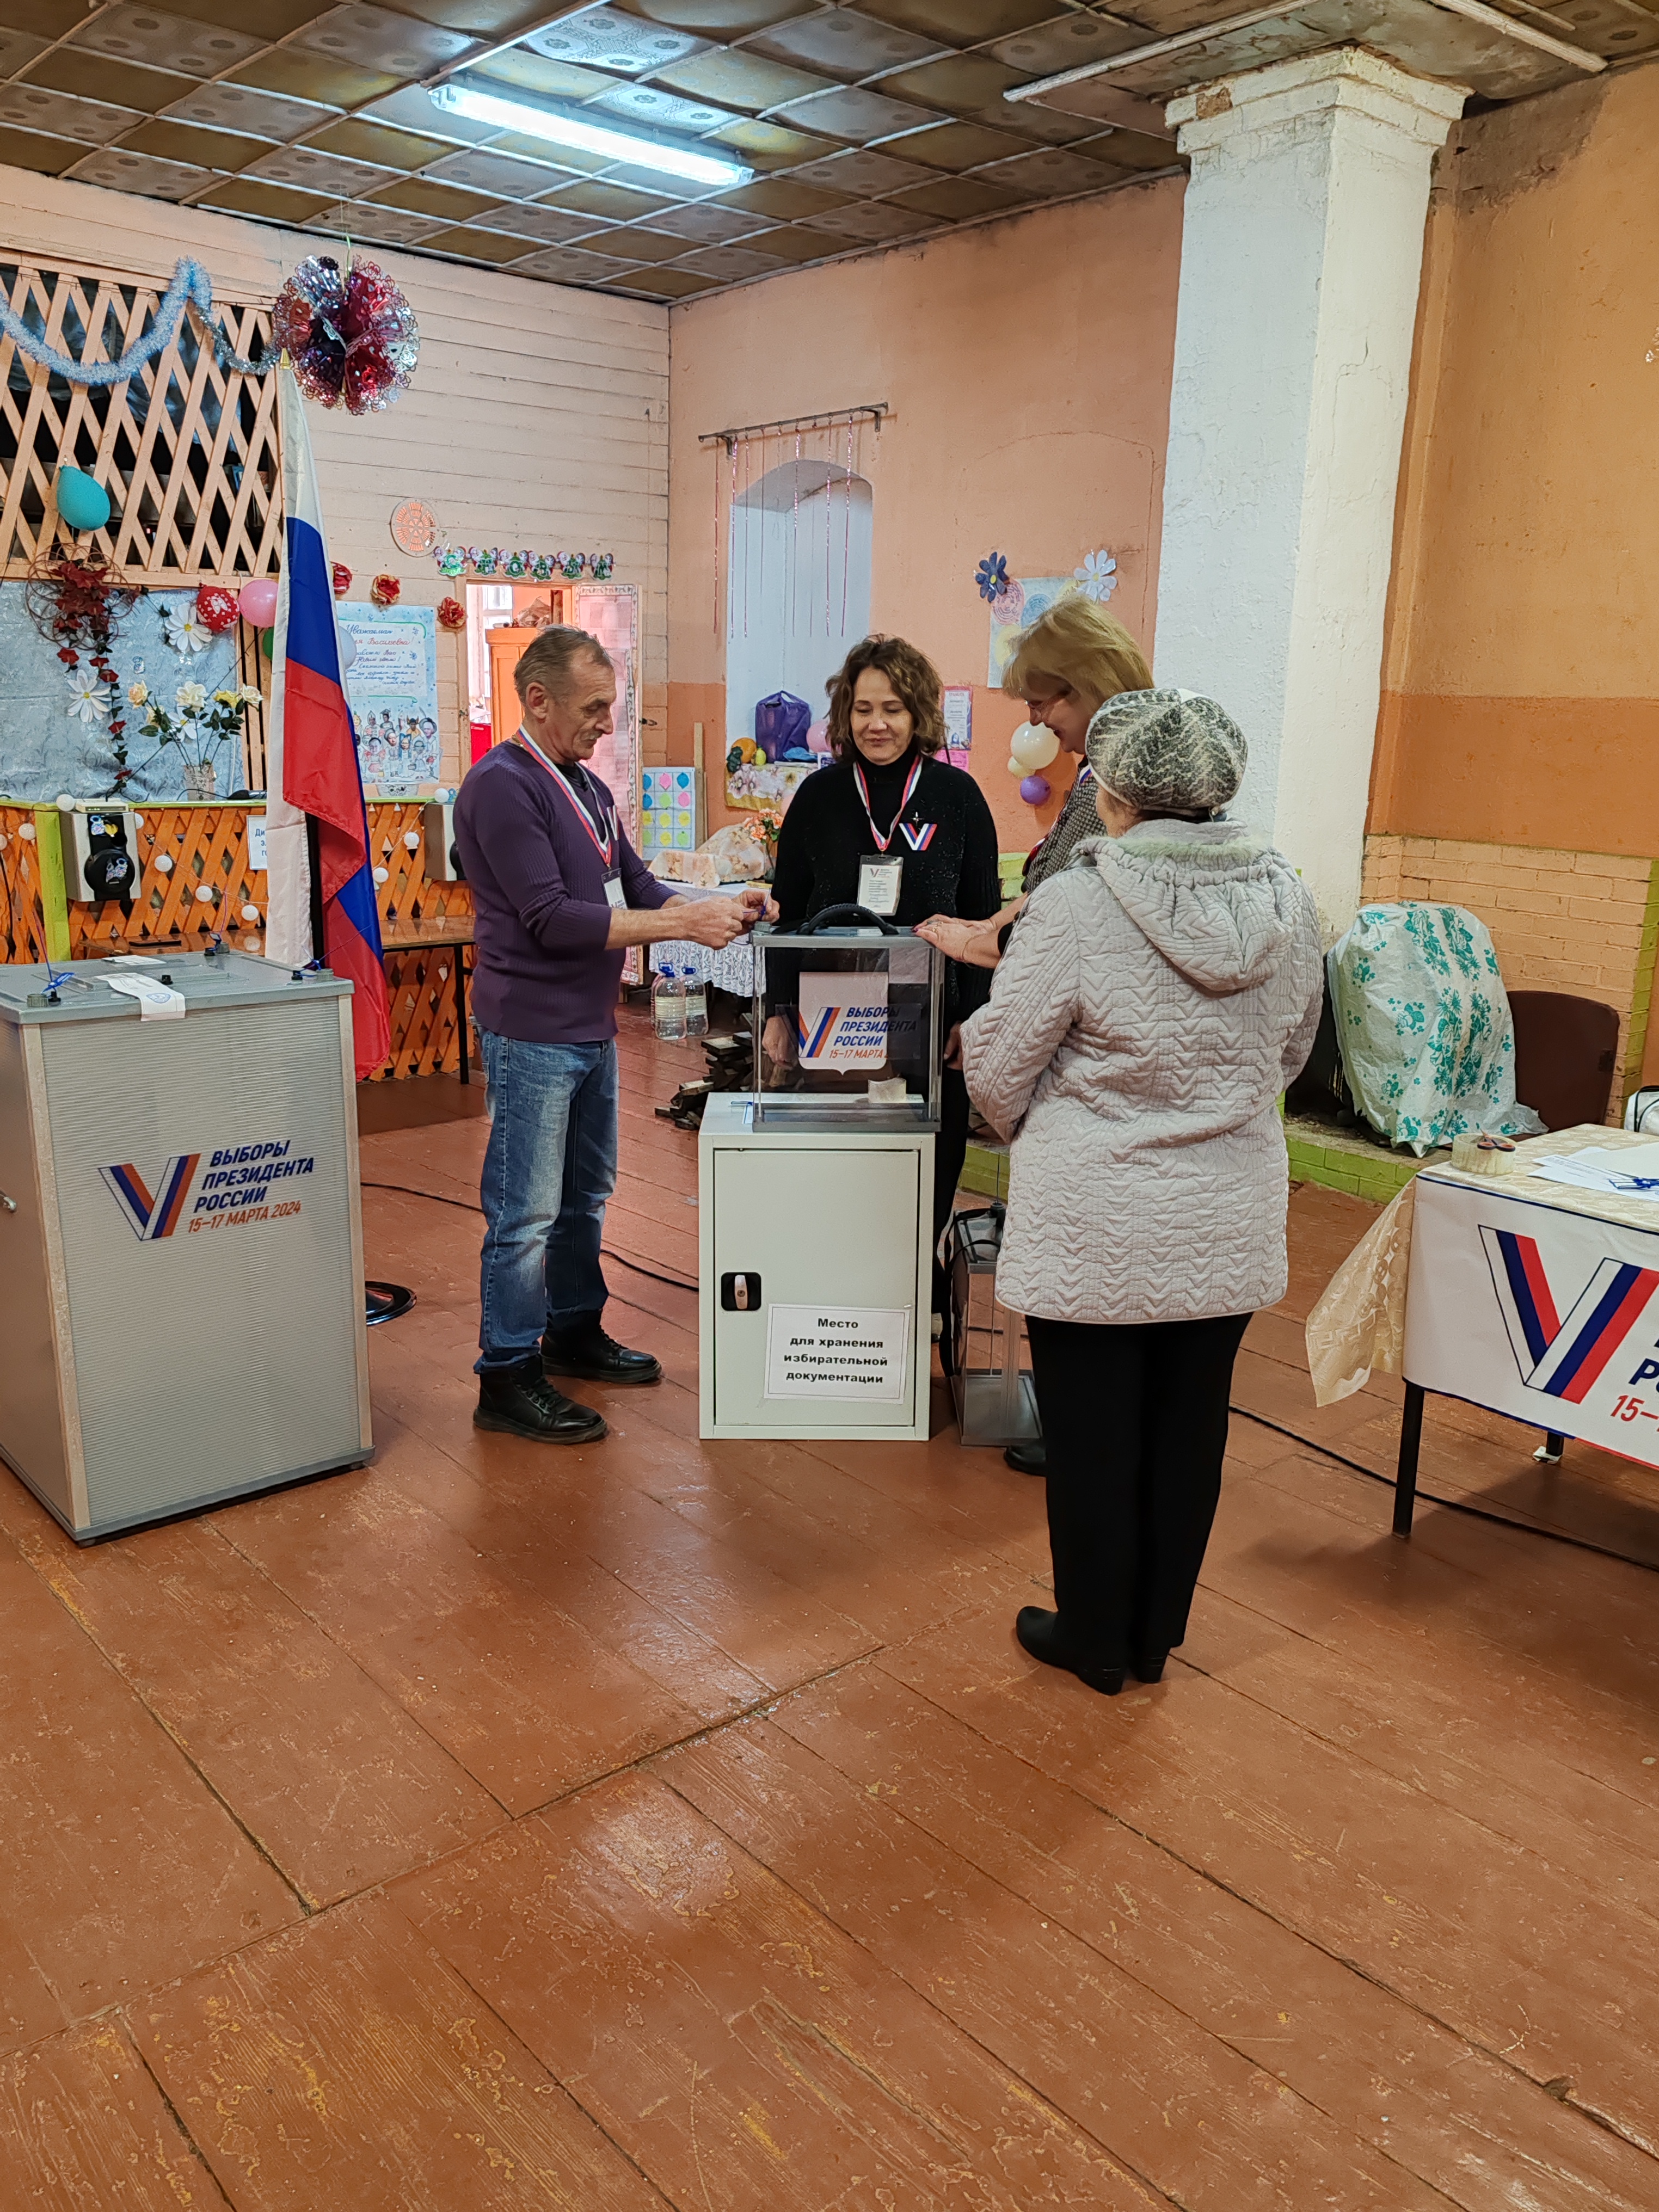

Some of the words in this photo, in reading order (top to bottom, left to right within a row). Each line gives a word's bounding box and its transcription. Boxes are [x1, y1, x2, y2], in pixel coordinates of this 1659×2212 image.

[346, 624, 394, 635] Уважаемая
[846, 1006, 900, 1018] ВЫБОРЫ
[839, 1020, 917, 1033] ПРЕЗИДЕНТА
[833, 1036, 884, 1047] РОССИИ
[853, 1049, 883, 1059] МАРТА
[210, 1140, 291, 1168] ВЫБОРЫ
[201, 1157, 315, 1190] ПРЕЗИДЕНТА
[193, 1185, 268, 1213] РОССИИ
[225, 1206, 269, 1226] МАРТА
[271, 1200, 302, 1219] 2024
[818, 1318, 859, 1329] Место
[790, 1337, 815, 1347] для
[819, 1338, 883, 1348] хранения
[784, 1354, 888, 1366] избирательной
[785, 1372, 883, 1384] документации
[1628, 1357, 1659, 1394] Р
